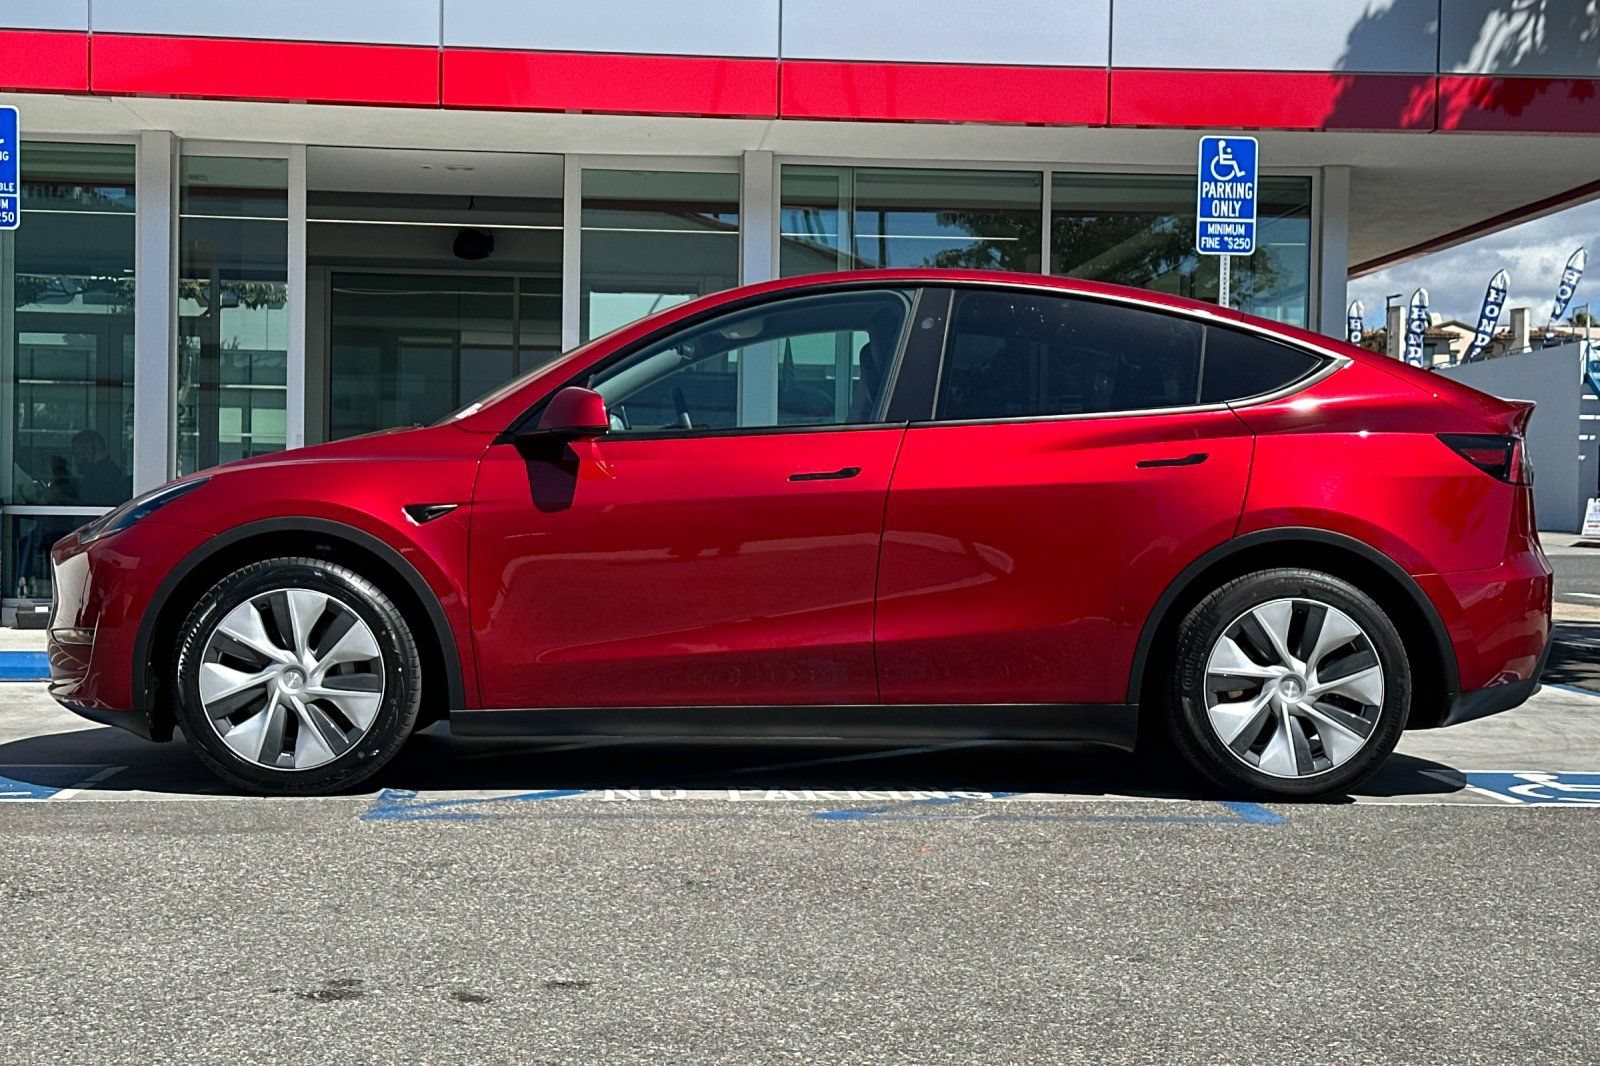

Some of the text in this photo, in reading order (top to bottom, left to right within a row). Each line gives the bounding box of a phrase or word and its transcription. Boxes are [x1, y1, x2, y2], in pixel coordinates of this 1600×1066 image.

[1202, 181, 1253, 199] PARKING
[1211, 200, 1242, 217] ONLY
[1207, 223, 1246, 236] MINIMUM
[1201, 236, 1251, 250] FINE $250
